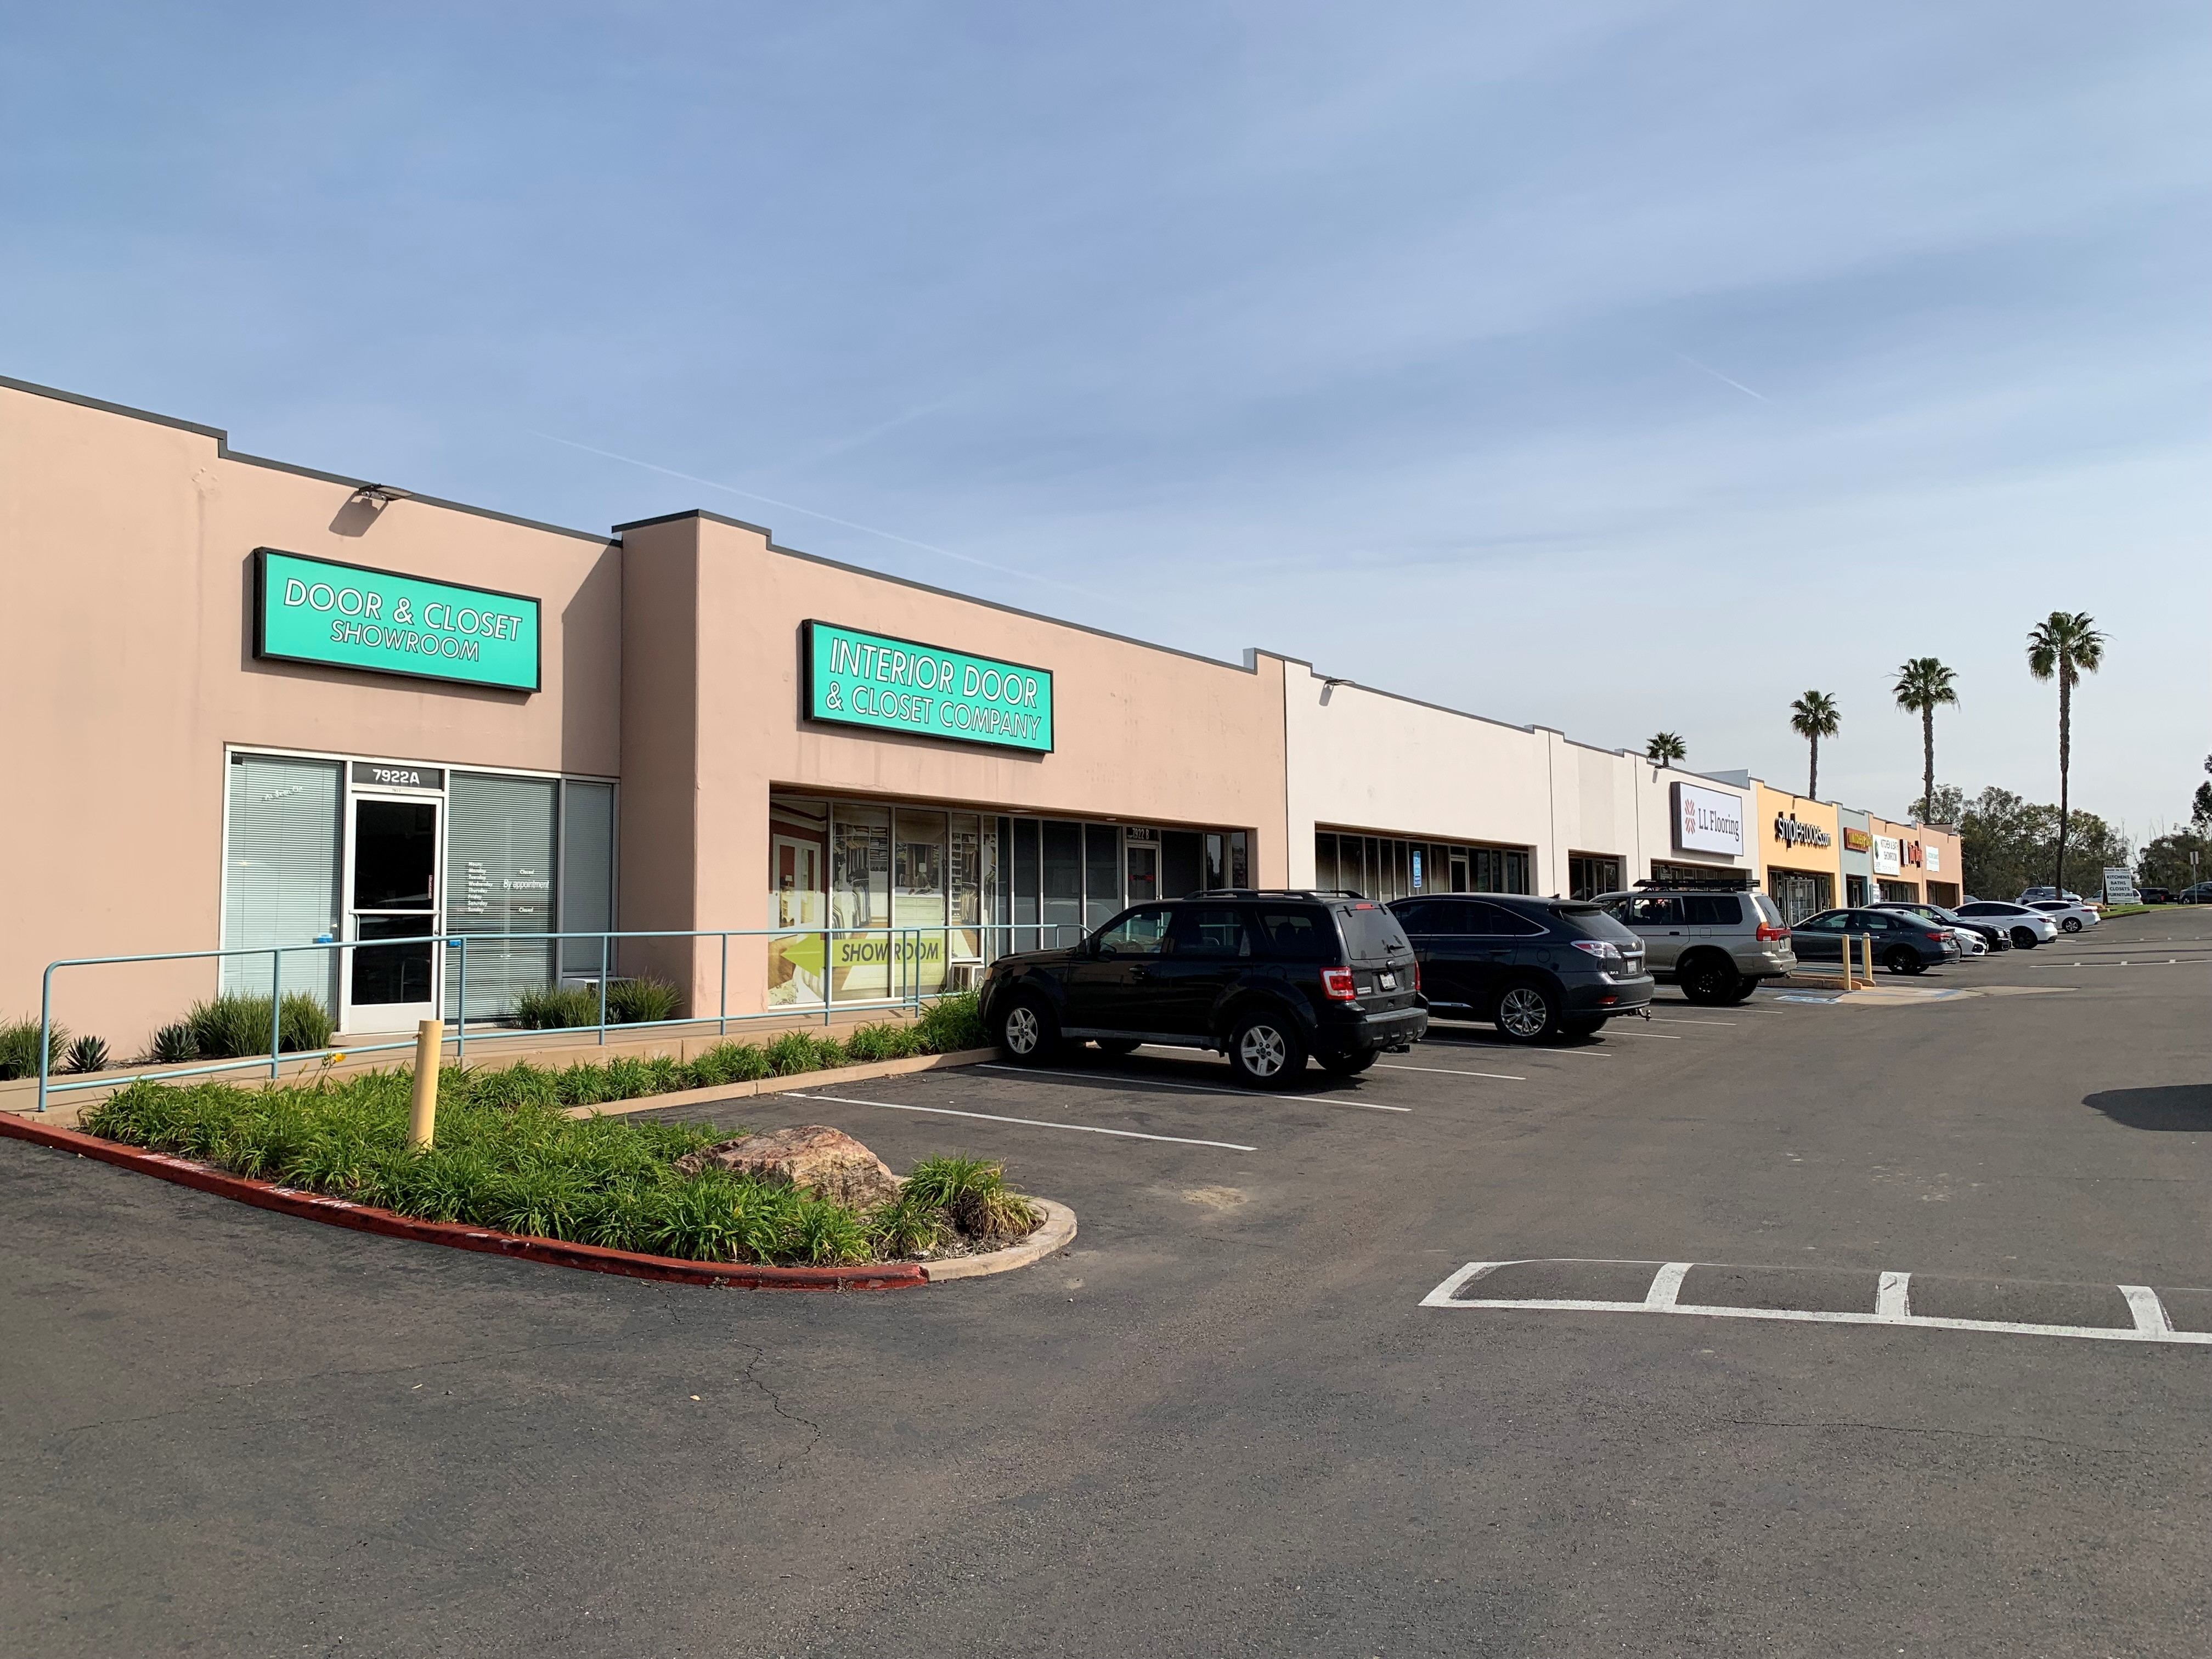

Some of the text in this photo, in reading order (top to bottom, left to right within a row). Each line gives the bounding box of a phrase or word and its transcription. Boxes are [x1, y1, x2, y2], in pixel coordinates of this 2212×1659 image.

[284, 578, 523, 641] DOOR & CLOSET
[330, 620, 479, 662] SHOWROOM
[830, 637, 1038, 709] INTERIOR DOOR
[825, 680, 1042, 741] & CLOSET COMPANY
[373, 769, 420, 785] 7922A
[1132, 827, 1149, 840] 7922 B
[1699, 808, 1740, 842] LL Flooring
[504, 879, 511, 890] By
[512, 880, 549, 890] appointment
[842, 942, 939, 962] SHOWROOM
